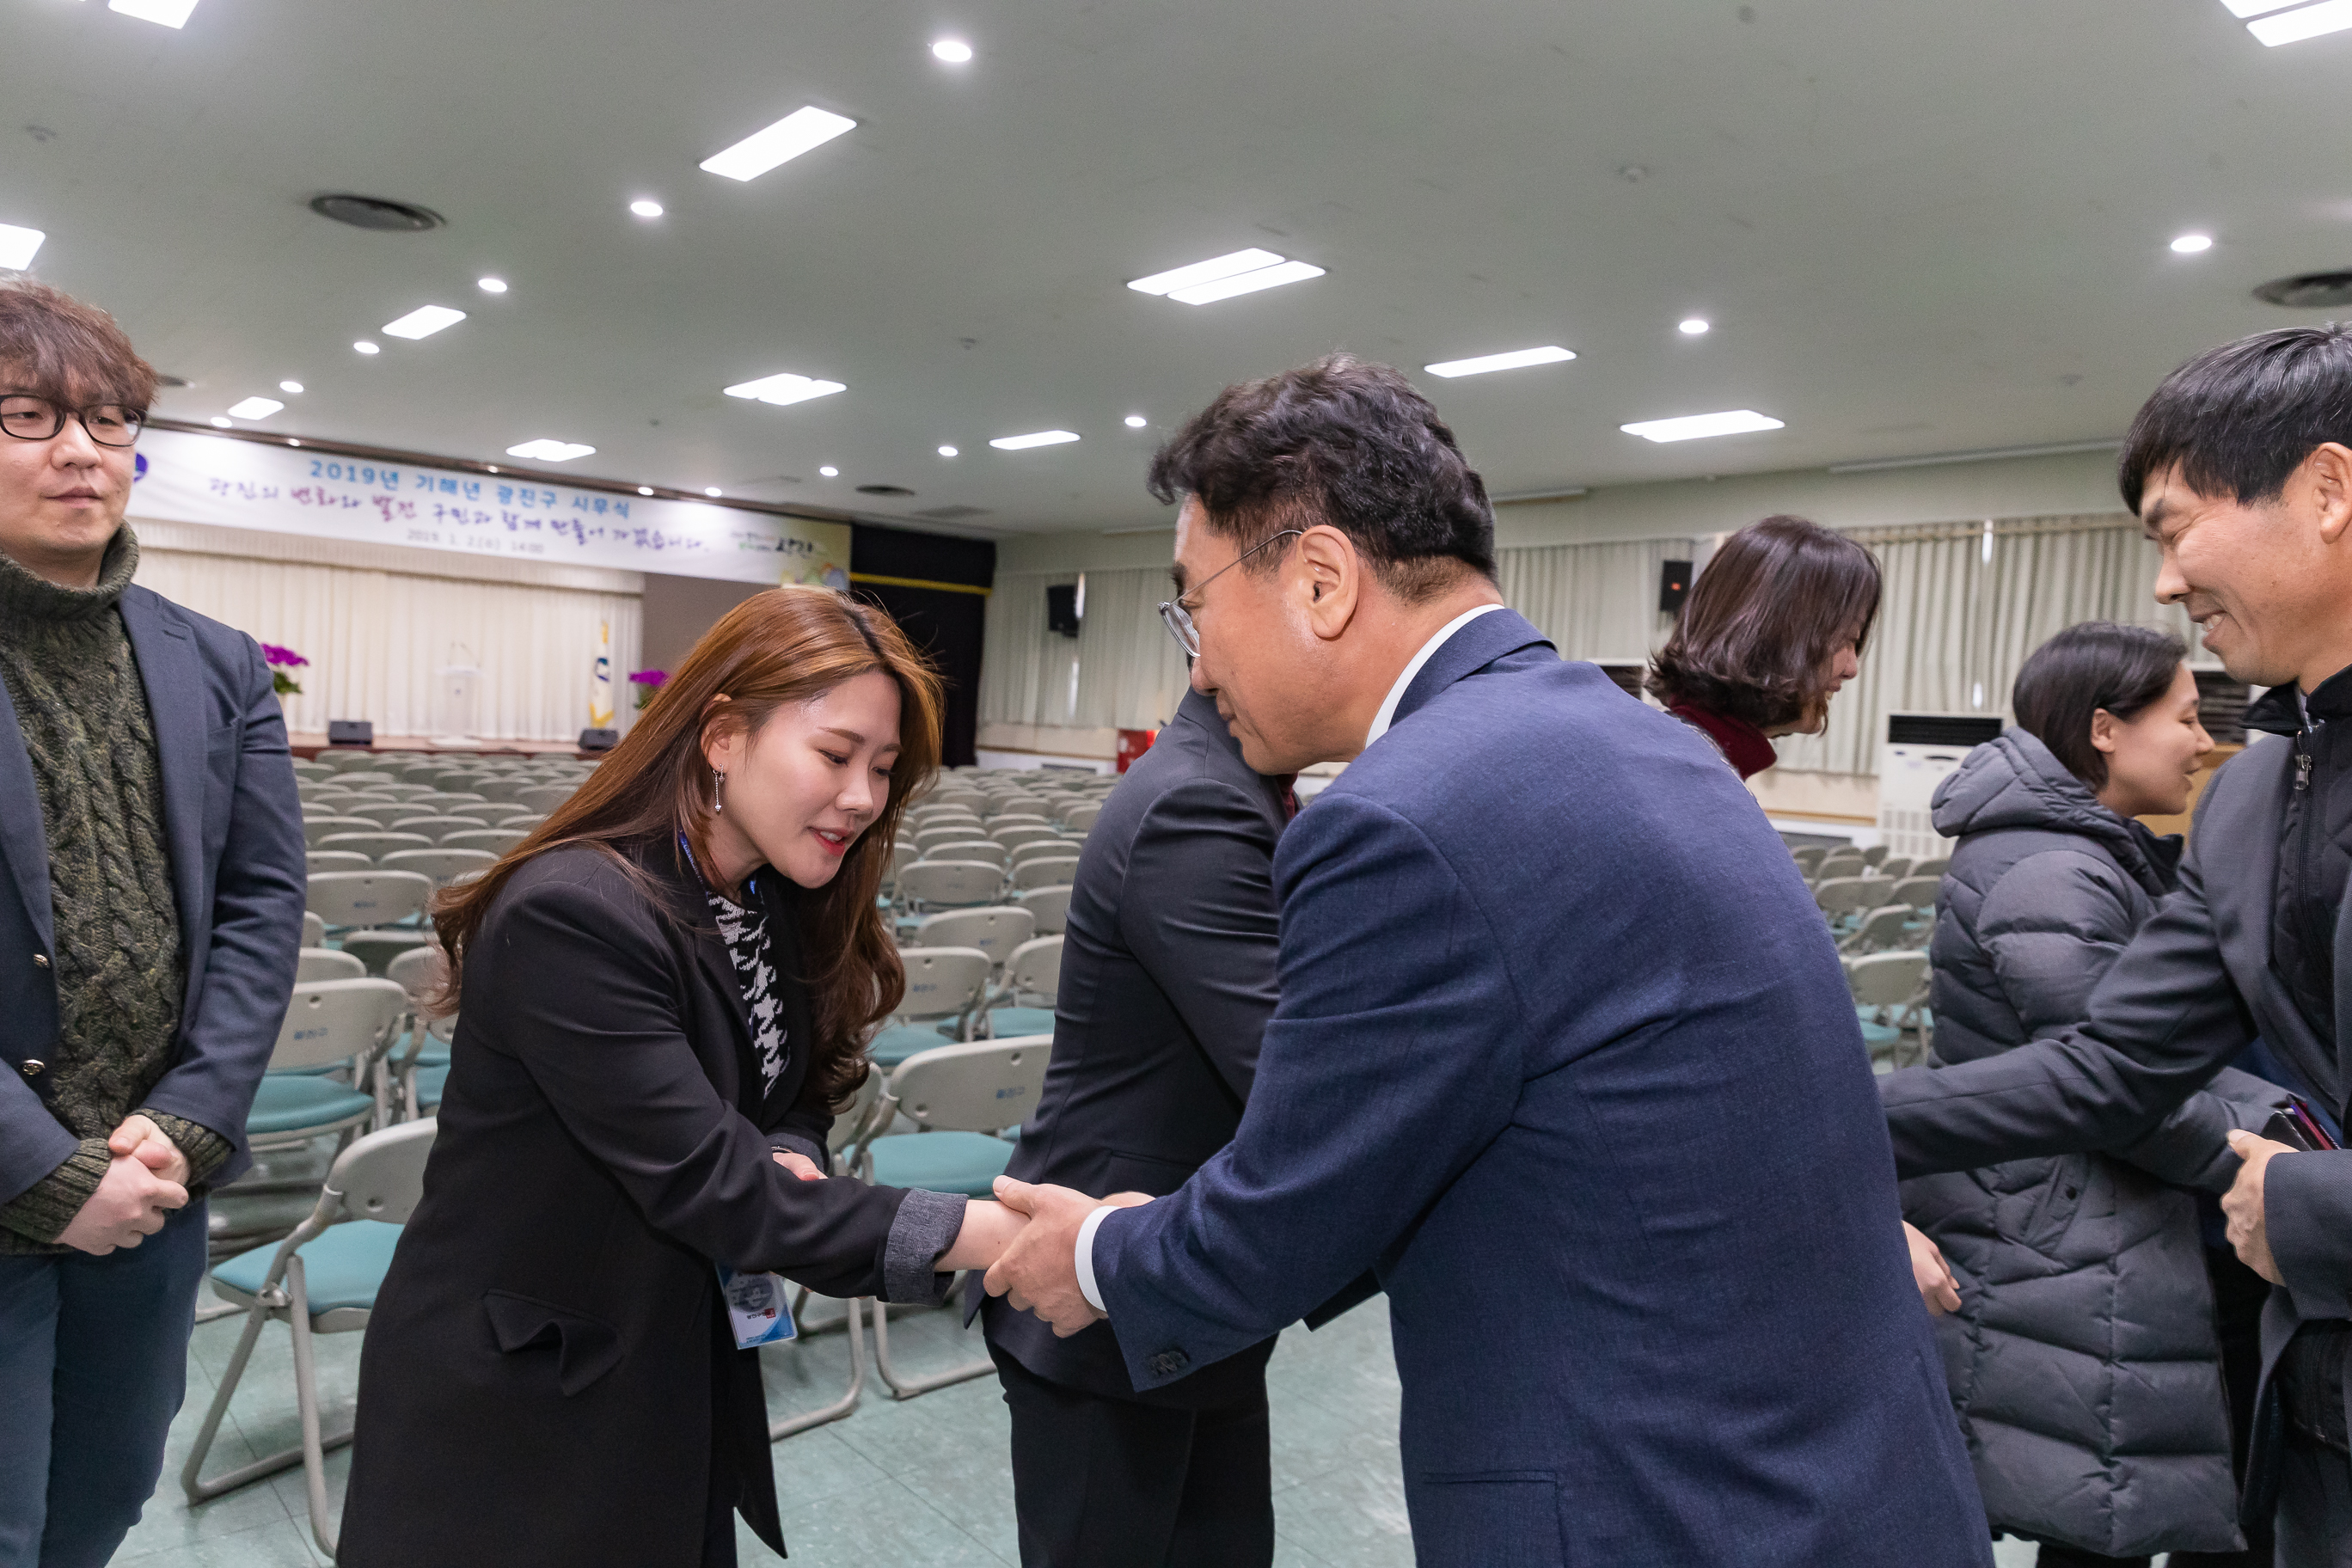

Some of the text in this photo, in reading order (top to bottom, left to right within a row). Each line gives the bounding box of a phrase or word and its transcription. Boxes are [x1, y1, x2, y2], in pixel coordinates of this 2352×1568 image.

[310, 459, 398, 490] 2019년
[415, 474, 481, 501] 기해년
[498, 484, 557, 509] 광진구
